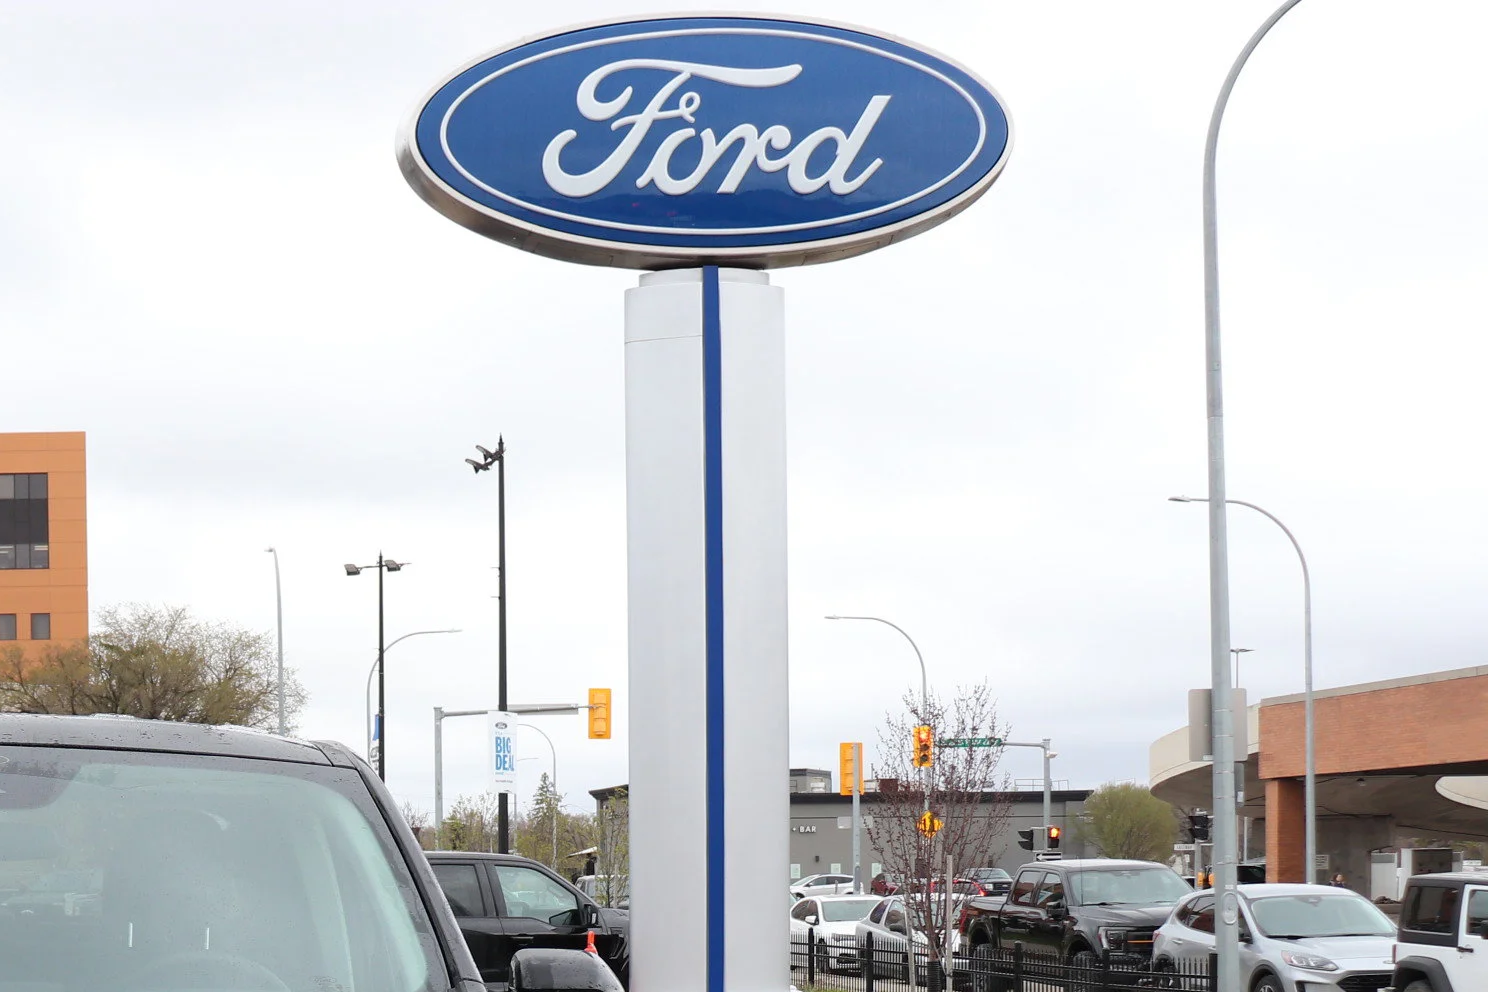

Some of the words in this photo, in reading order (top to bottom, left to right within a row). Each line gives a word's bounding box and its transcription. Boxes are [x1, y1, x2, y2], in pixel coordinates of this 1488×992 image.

[542, 58, 892, 198] Ford
[495, 737, 512, 754] BIG
[495, 753, 515, 771] DEAL
[799, 825, 817, 833] BAR
